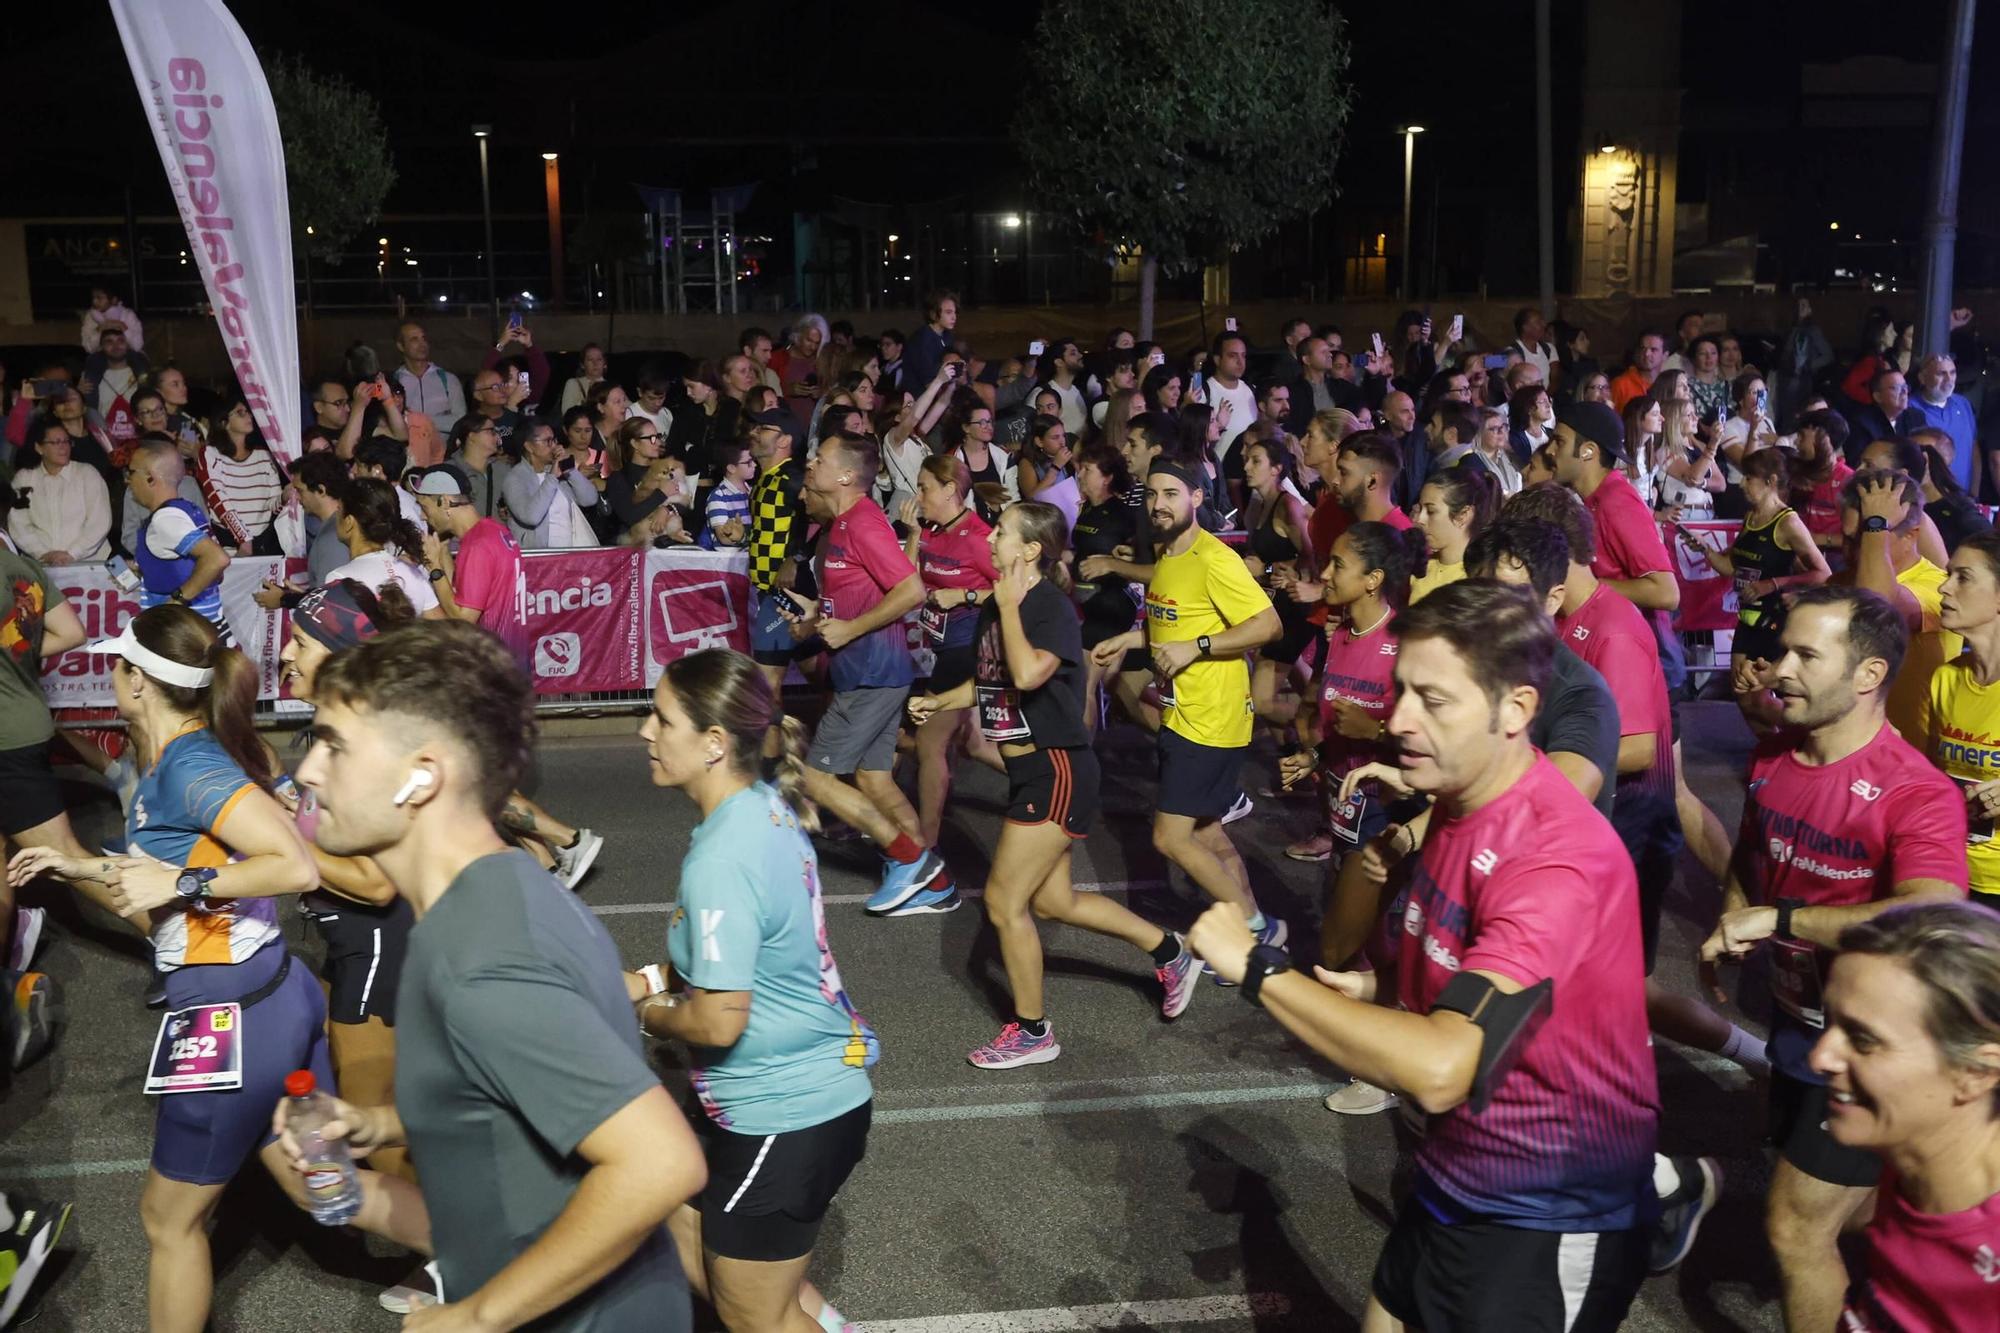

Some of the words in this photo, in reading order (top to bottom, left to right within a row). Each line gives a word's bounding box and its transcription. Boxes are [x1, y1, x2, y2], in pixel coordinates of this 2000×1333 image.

[627, 552, 640, 682] www.fibravalencia.es
[548, 666, 567, 675] FIJO
[985, 705, 1010, 721] 2621
